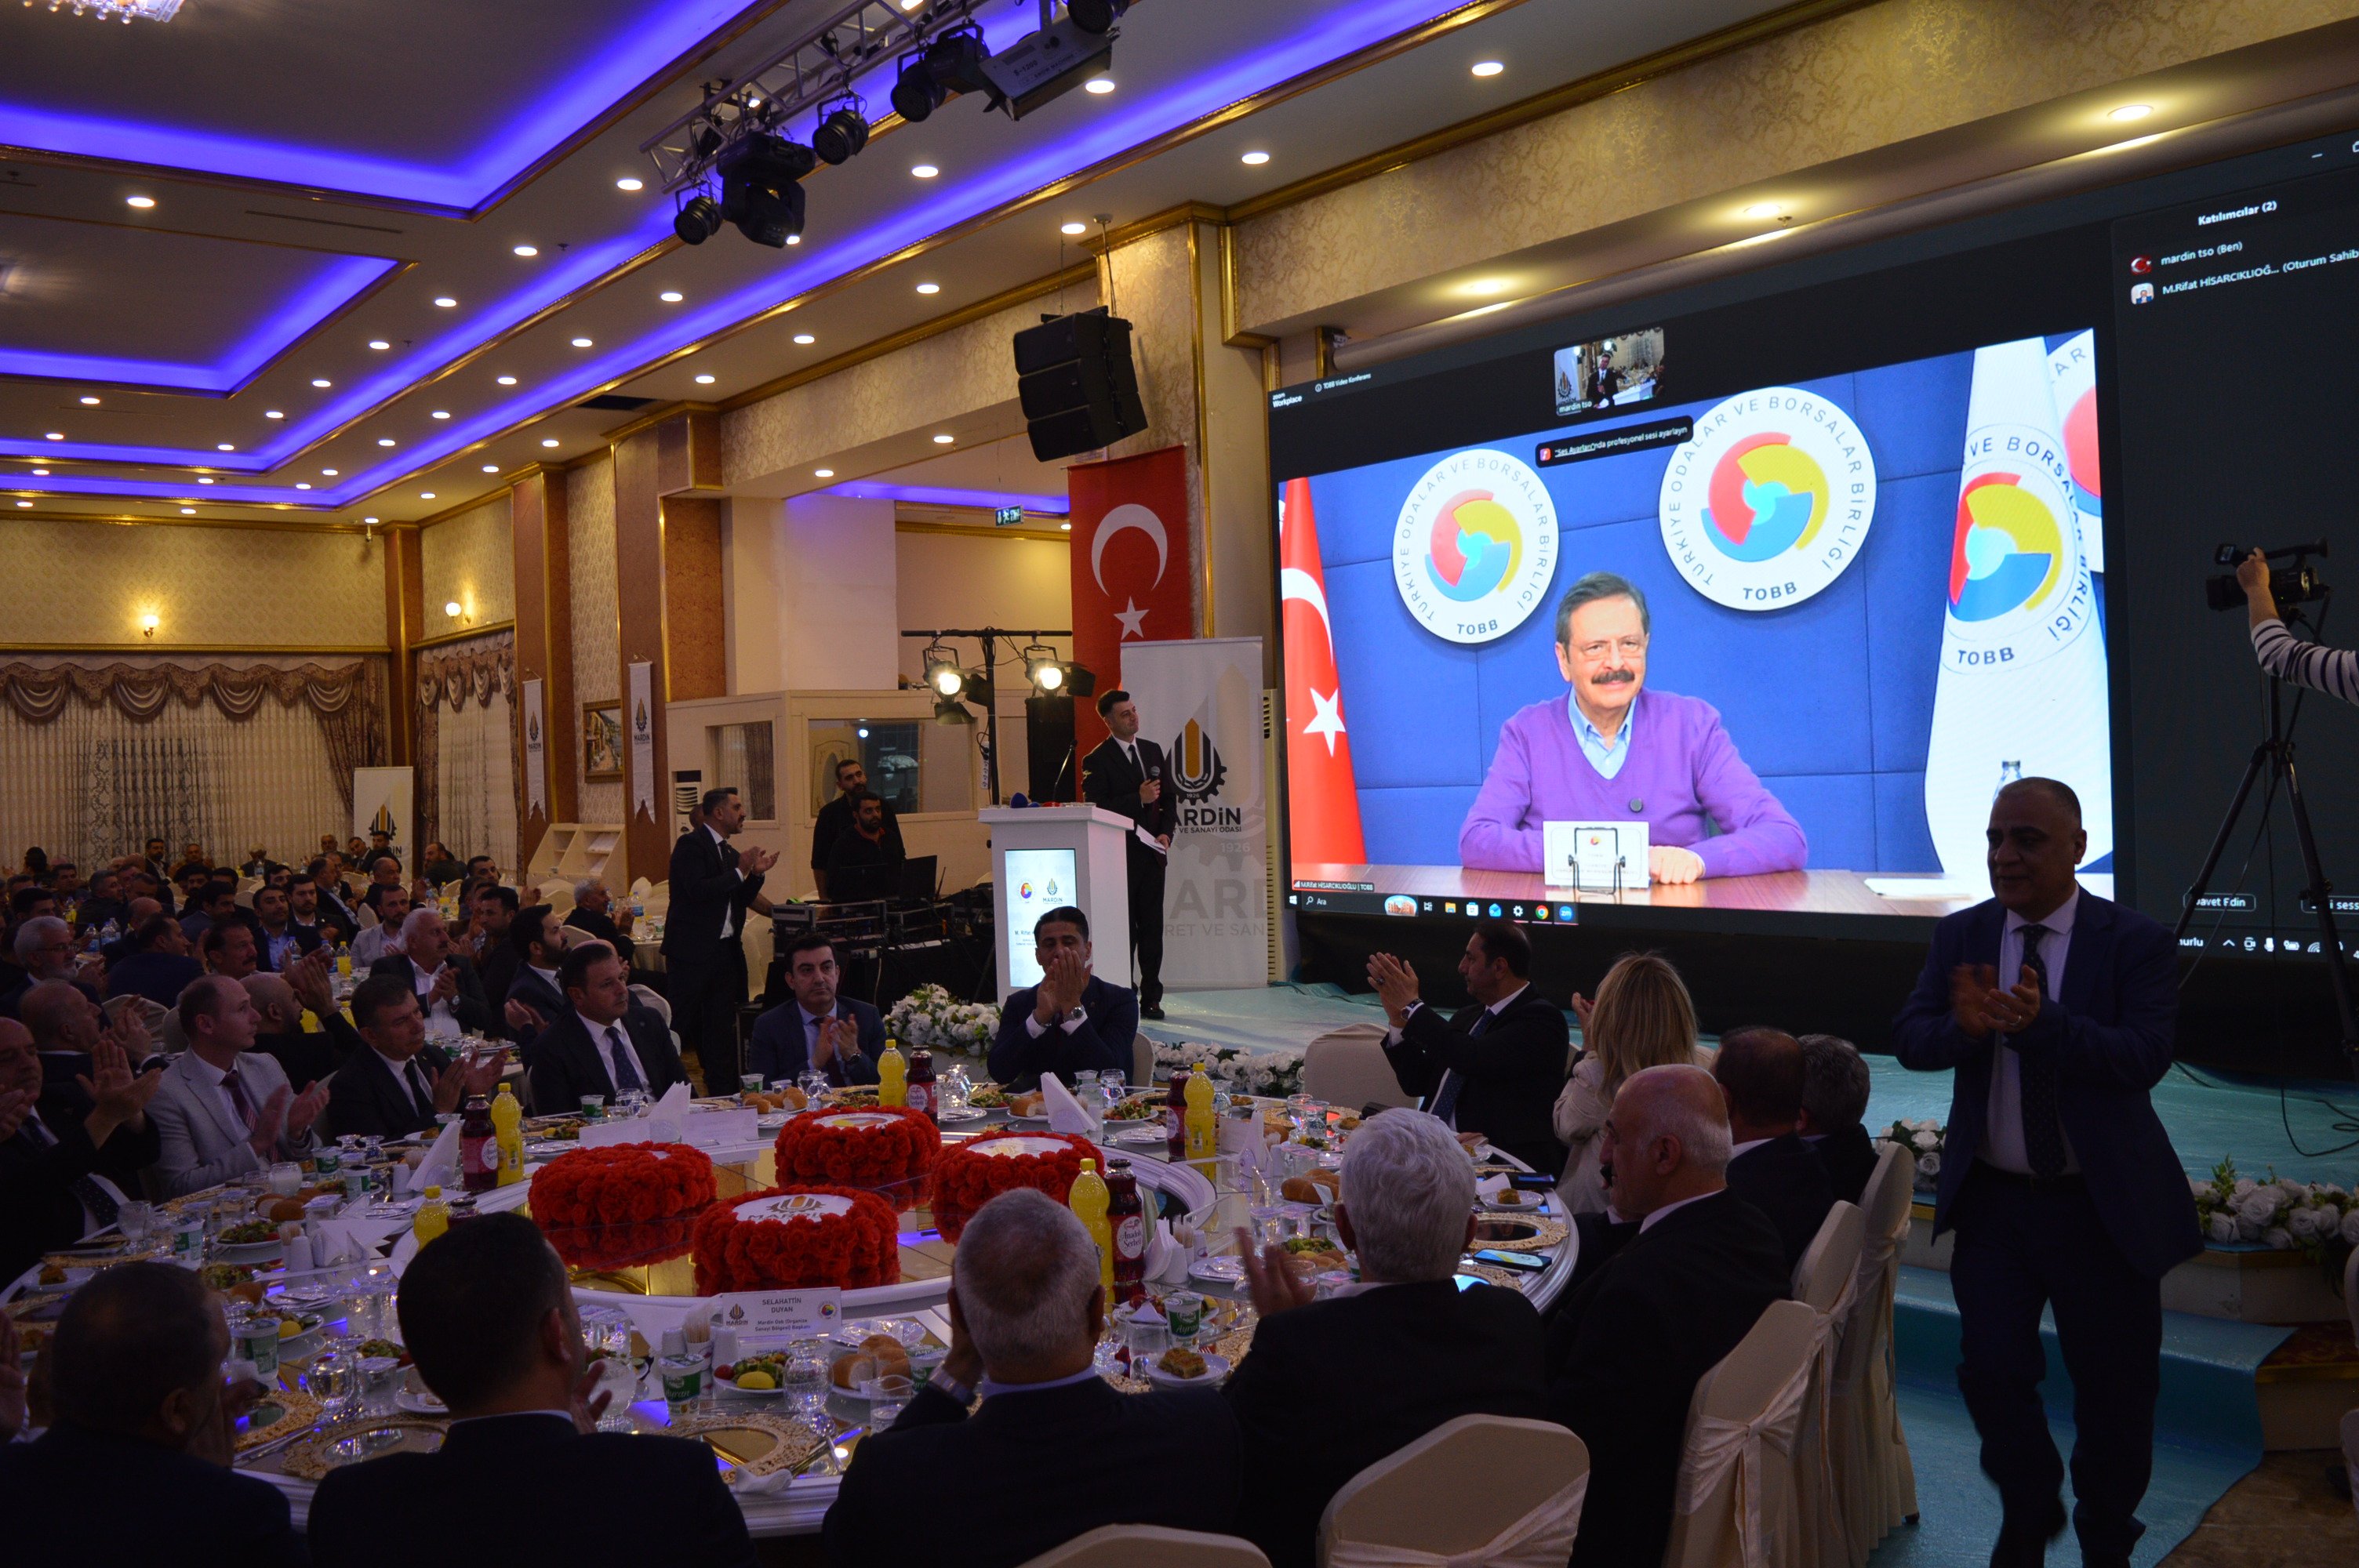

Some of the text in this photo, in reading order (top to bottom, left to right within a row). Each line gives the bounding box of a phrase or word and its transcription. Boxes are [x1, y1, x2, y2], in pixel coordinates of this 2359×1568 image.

[2198, 201, 2277, 226] Katılımcılar (2)
[2161, 241, 2242, 265] mardin tso (Ben)
[2162, 281, 2197, 295] M.Rifat
[2283, 256, 2327, 273] (Oturum
[1273, 395, 1303, 408] Workplace
[1670, 413, 1727, 492] ODALAR
[1734, 398, 1759, 416] VE
[1769, 396, 1863, 474] BORSALAR
[1970, 437, 1993, 456] VE
[1402, 471, 1445, 539] ODALAR
[1450, 458, 1469, 474] VE
[1478, 457, 1548, 527] BORSALAR
[1743, 581, 1797, 601] TOBB
[1456, 619, 1499, 635] TOBB
[1957, 647, 2015, 665] TOBB
[1221, 842, 1250, 852] 1926
[1201, 924, 1223, 936] VE
